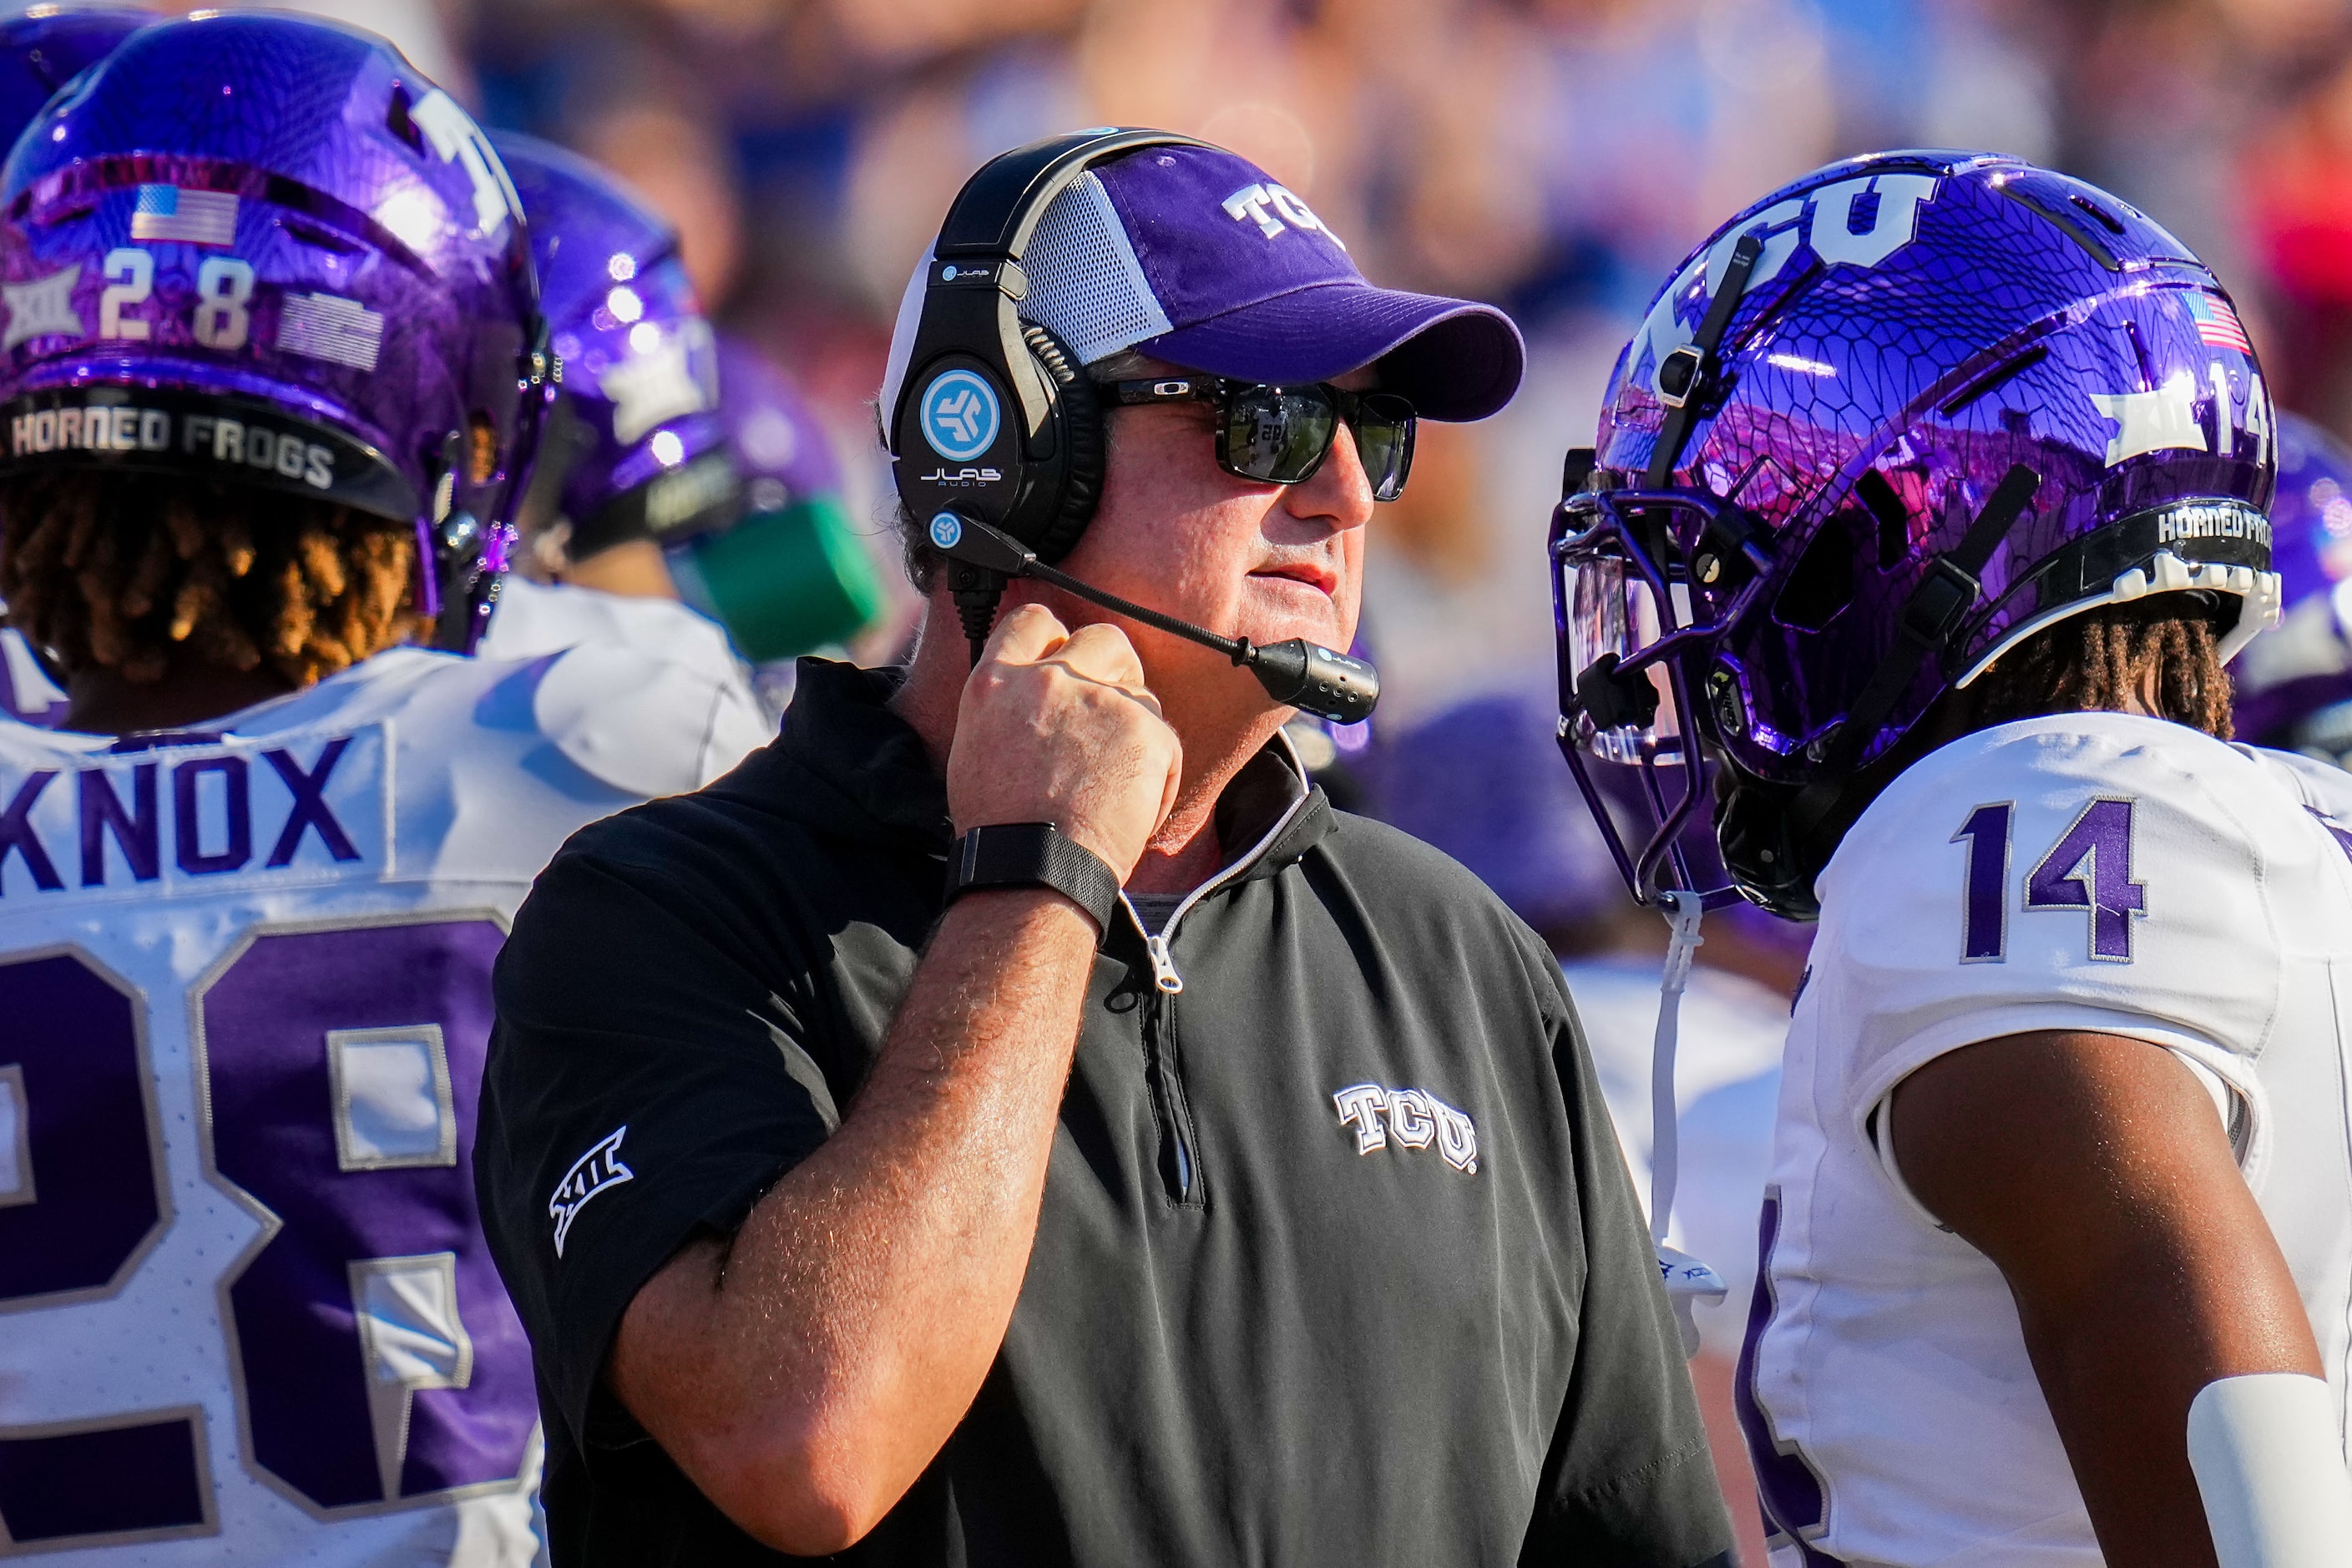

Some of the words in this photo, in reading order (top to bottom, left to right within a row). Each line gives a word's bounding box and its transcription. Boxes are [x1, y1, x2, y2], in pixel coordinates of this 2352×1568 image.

[12, 406, 169, 458] HORNED
[183, 413, 334, 490] FROGS
[2209, 362, 2269, 466] 14
[920, 468, 1002, 481] JLAB
[2157, 507, 2244, 544] HORNED
[2243, 508, 2274, 553] FRO
[0, 736, 362, 898] KNOX
[1949, 794, 2149, 964] 14
[1333, 1084, 1478, 1171] TCU
